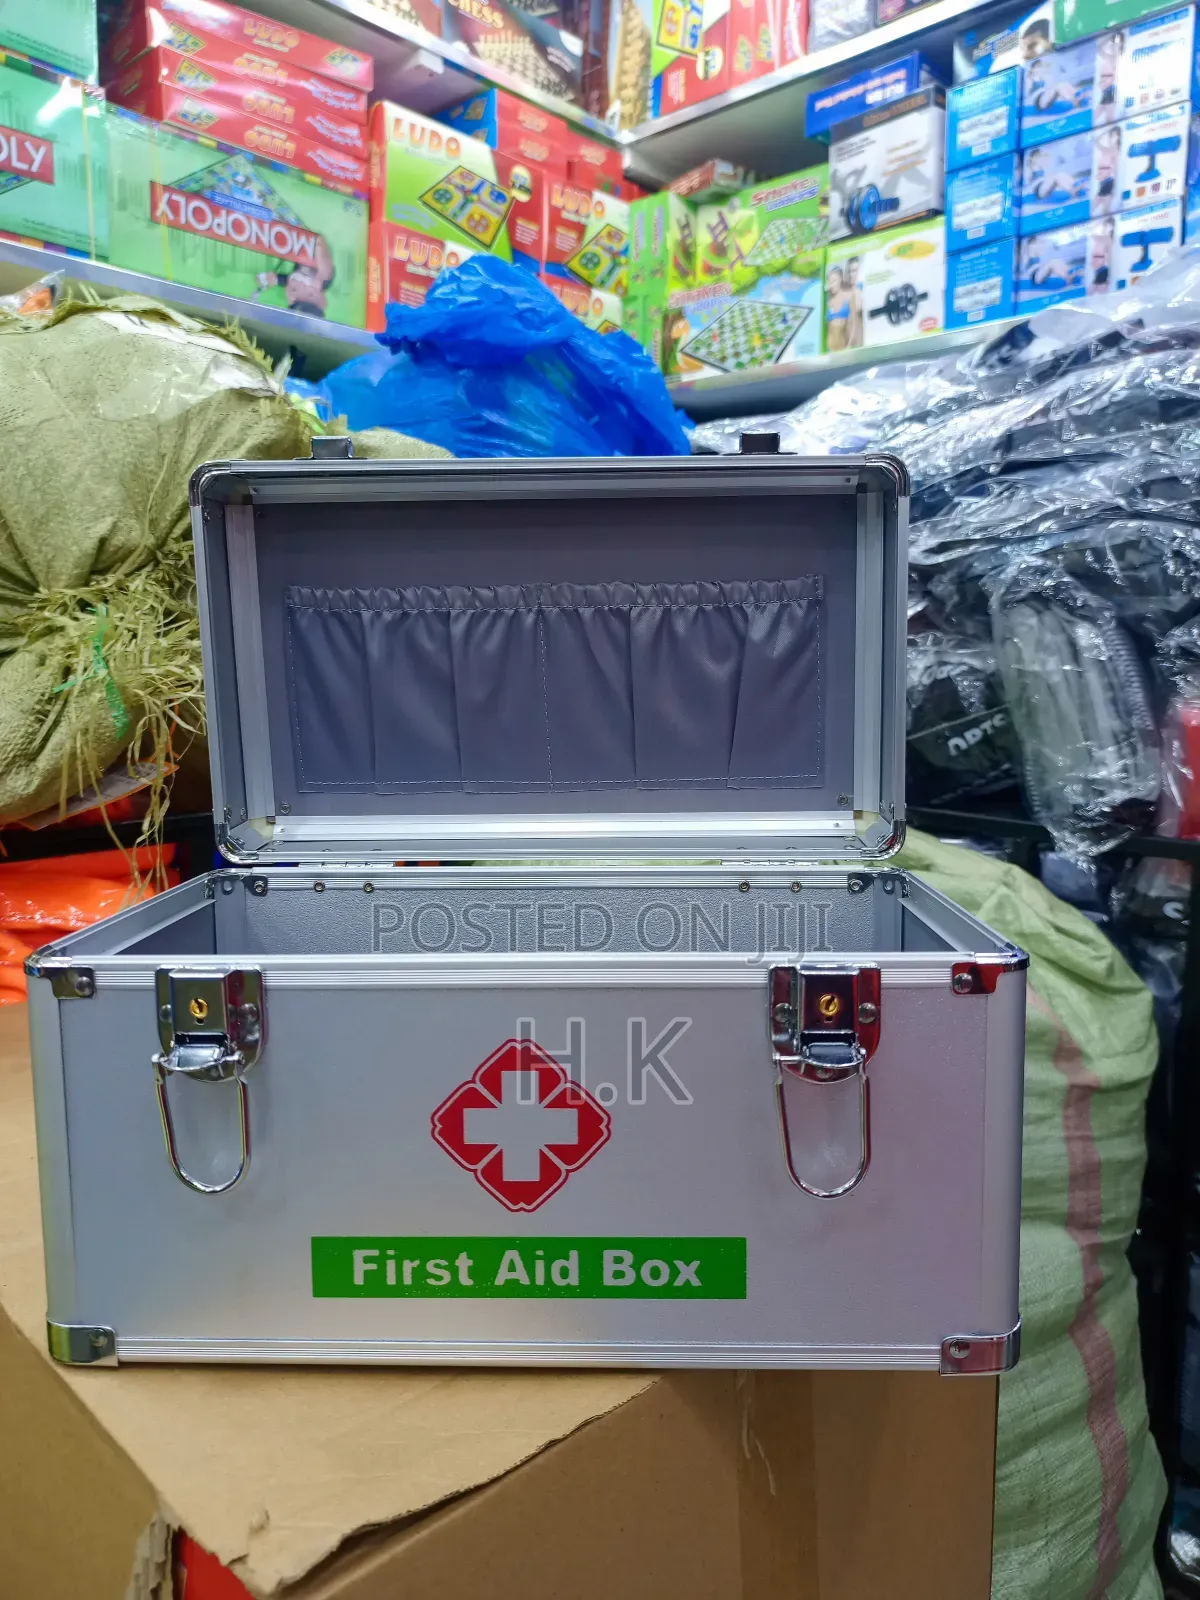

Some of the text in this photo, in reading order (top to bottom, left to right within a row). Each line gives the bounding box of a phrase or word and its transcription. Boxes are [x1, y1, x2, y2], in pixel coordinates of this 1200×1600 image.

[244, 129, 296, 159] LUDO
[393, 117, 461, 159] LUDO
[551, 183, 605, 218] LUDO
[156, 192, 315, 260] MONOPOLY
[393, 235, 460, 270] LUDO
[353, 1249, 701, 1286] First Aid Box
